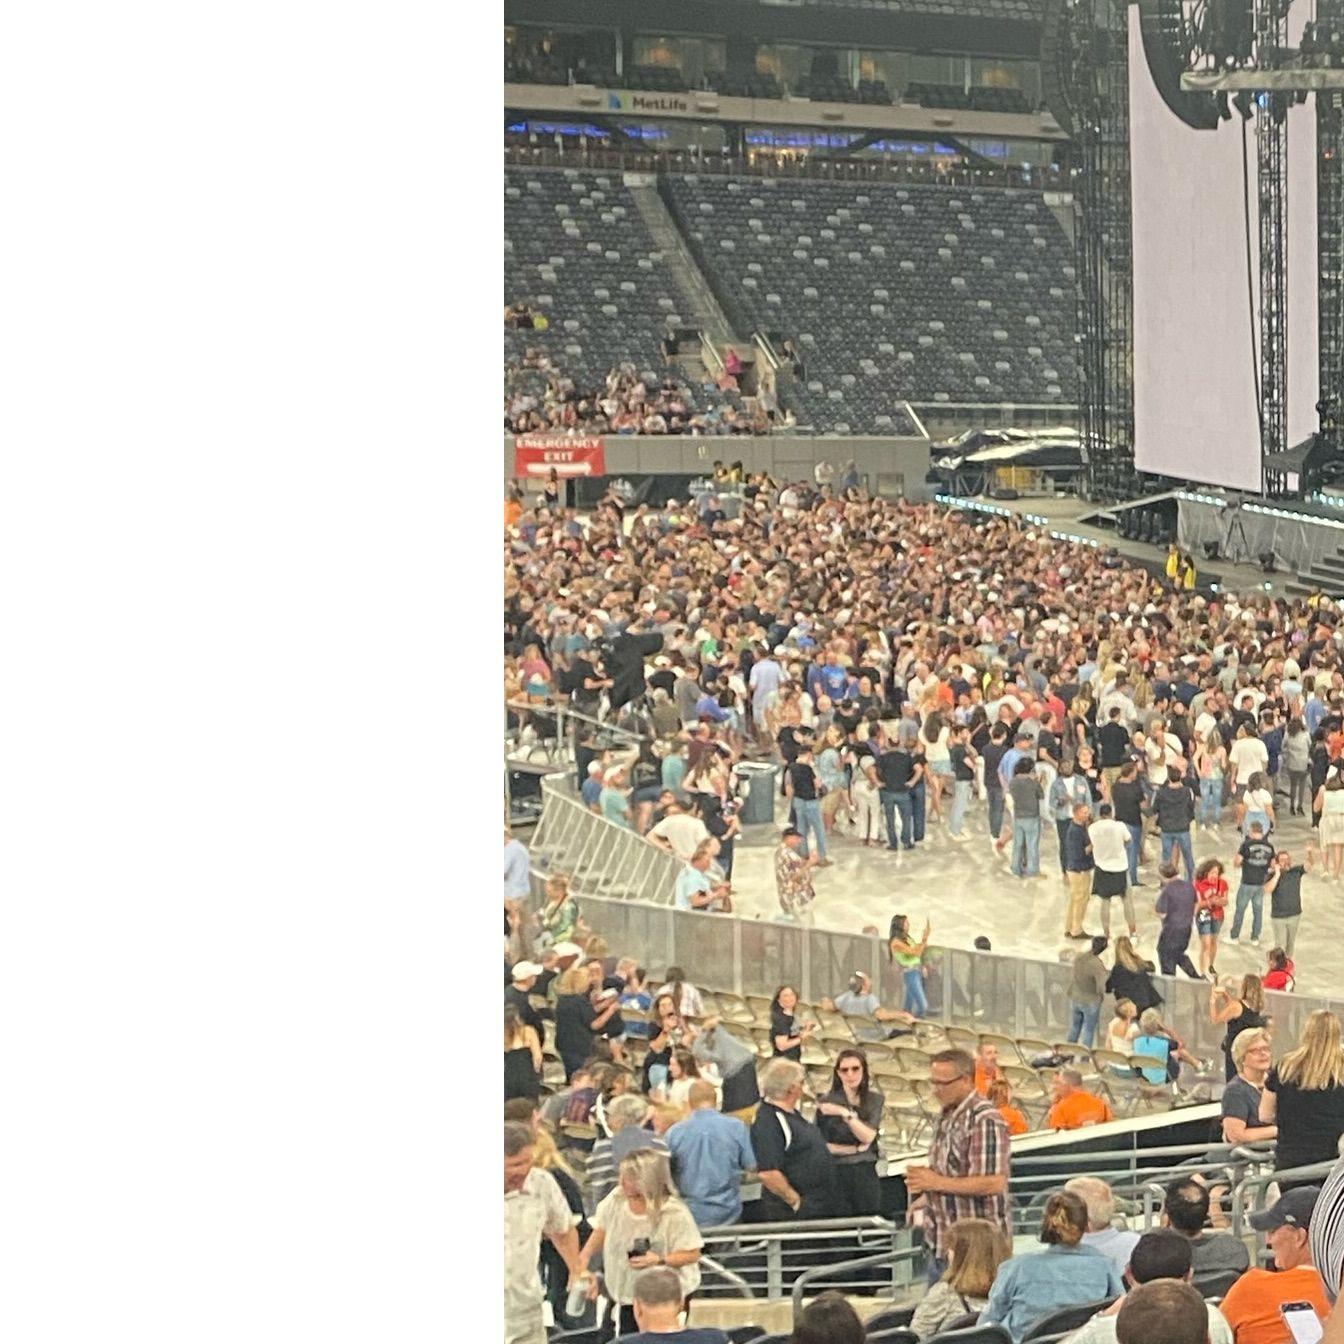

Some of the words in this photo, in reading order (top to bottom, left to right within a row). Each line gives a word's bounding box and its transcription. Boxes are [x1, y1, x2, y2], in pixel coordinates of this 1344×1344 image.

[632, 96, 687, 112] MetLife
[516, 438, 600, 449] EMERGENCY
[543, 451, 574, 462] EXIT
